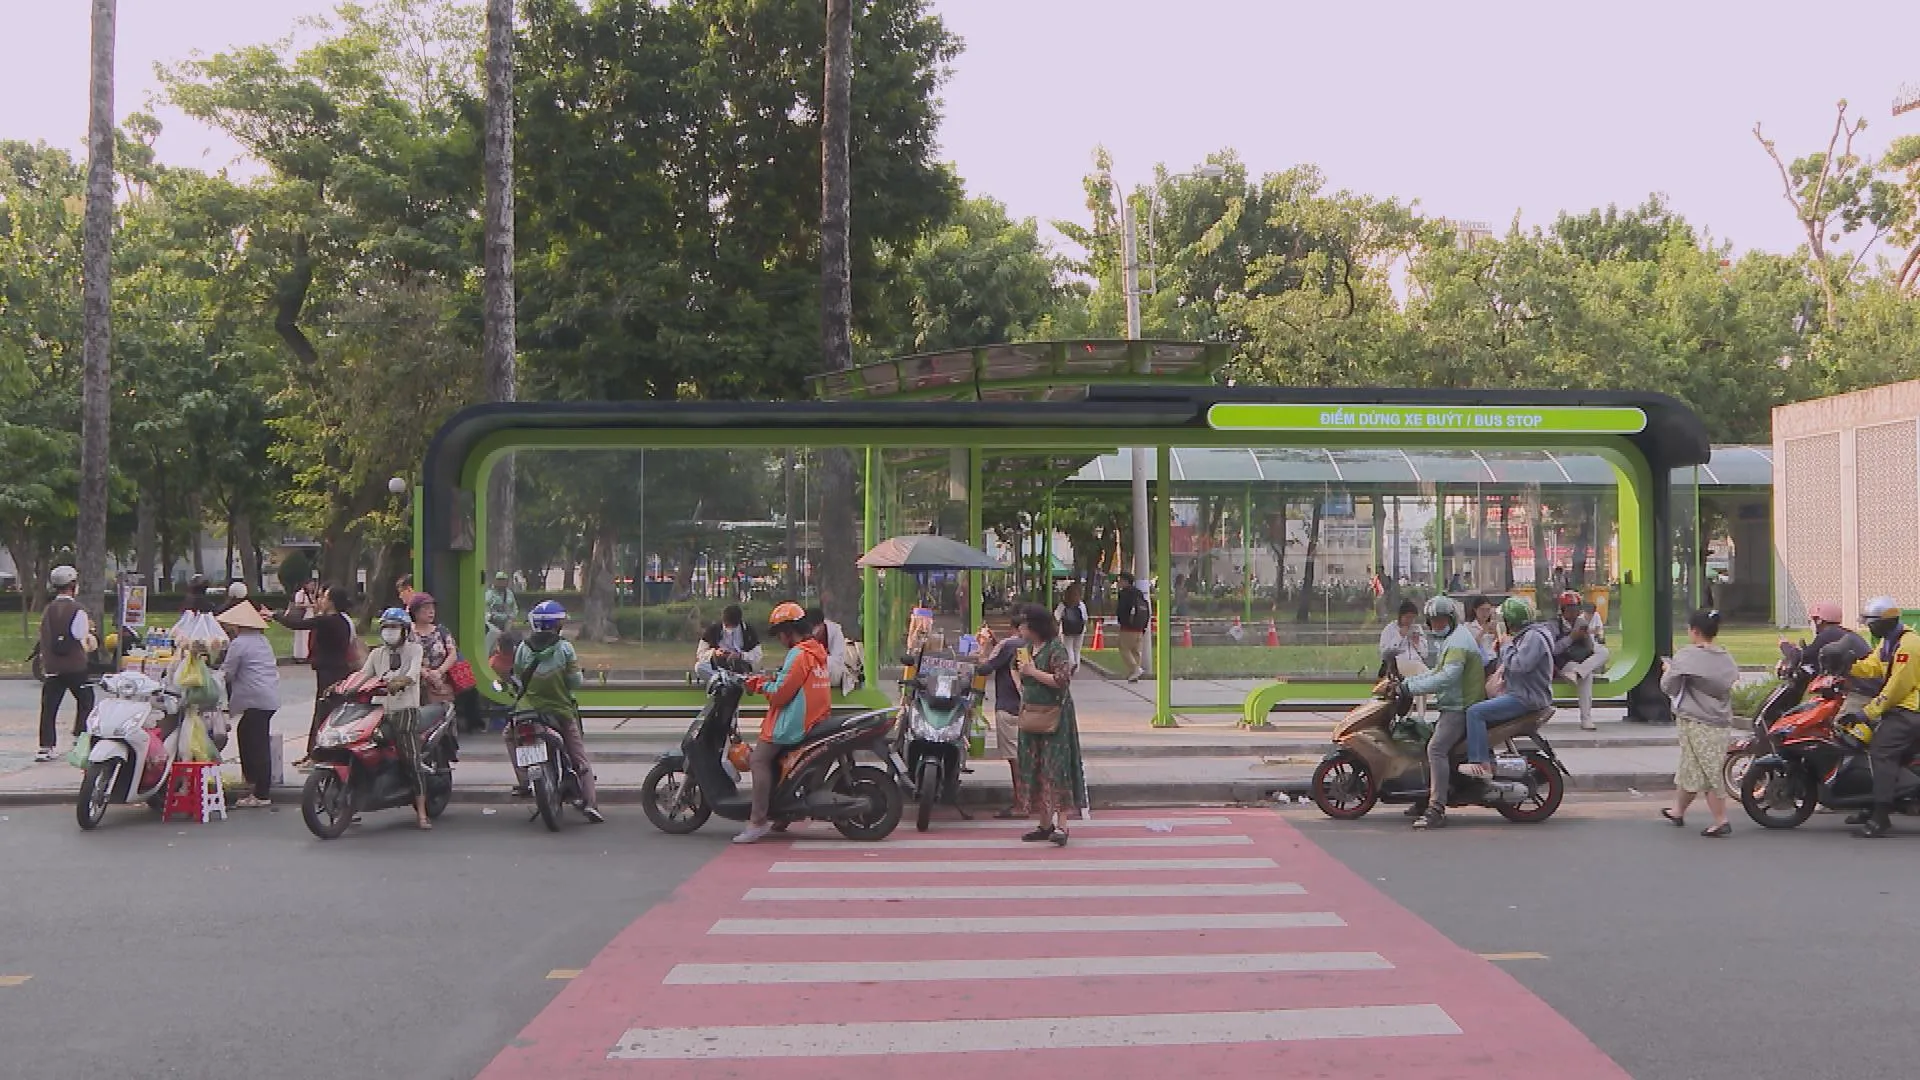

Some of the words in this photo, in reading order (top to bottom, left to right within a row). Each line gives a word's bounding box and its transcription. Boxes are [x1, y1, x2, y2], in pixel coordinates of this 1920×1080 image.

[1320, 407, 1355, 425] ĐIỂM
[1359, 409, 1400, 425] DỪNG
[1405, 413, 1423, 425] XE
[1426, 409, 1463, 426] BUÝT
[1475, 414, 1502, 427] BUS
[1507, 415, 1542, 427] STOP
